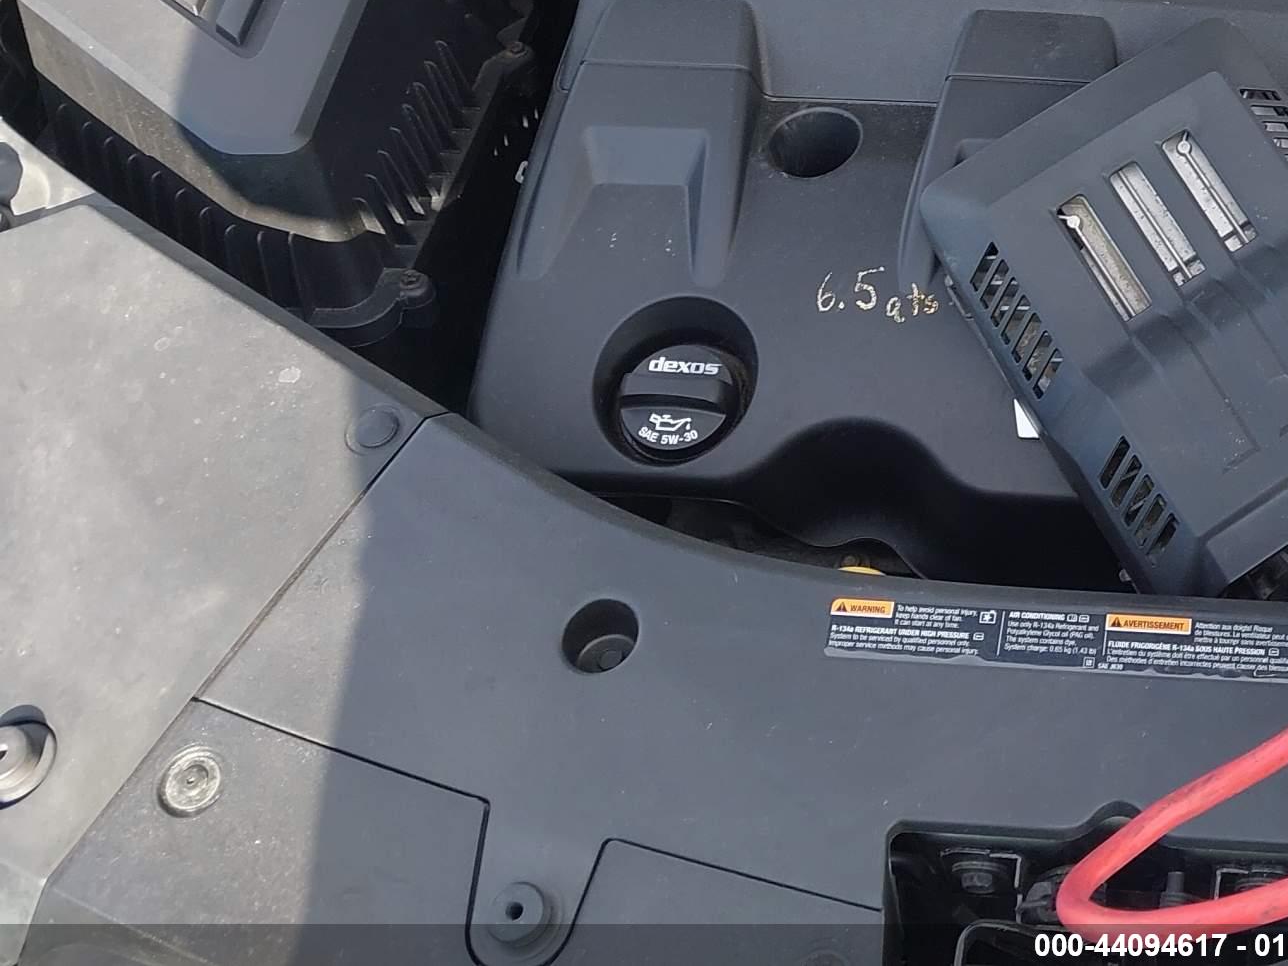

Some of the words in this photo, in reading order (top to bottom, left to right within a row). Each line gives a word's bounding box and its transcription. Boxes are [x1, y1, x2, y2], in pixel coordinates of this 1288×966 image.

[817, 267, 884, 311] 6.5
[649, 357, 722, 375] dexos
[638, 426, 658, 442] SAE
[661, 430, 698, 444] 5W-30
[850, 605, 885, 614] WARNING
[1021, 612, 1065, 621] CONDITIONING
[1123, 620, 1184, 630] AVERTISSEMENT
[854, 626, 897, 634] REFRIGERANT
[937, 631, 969, 639] PRESSURE
